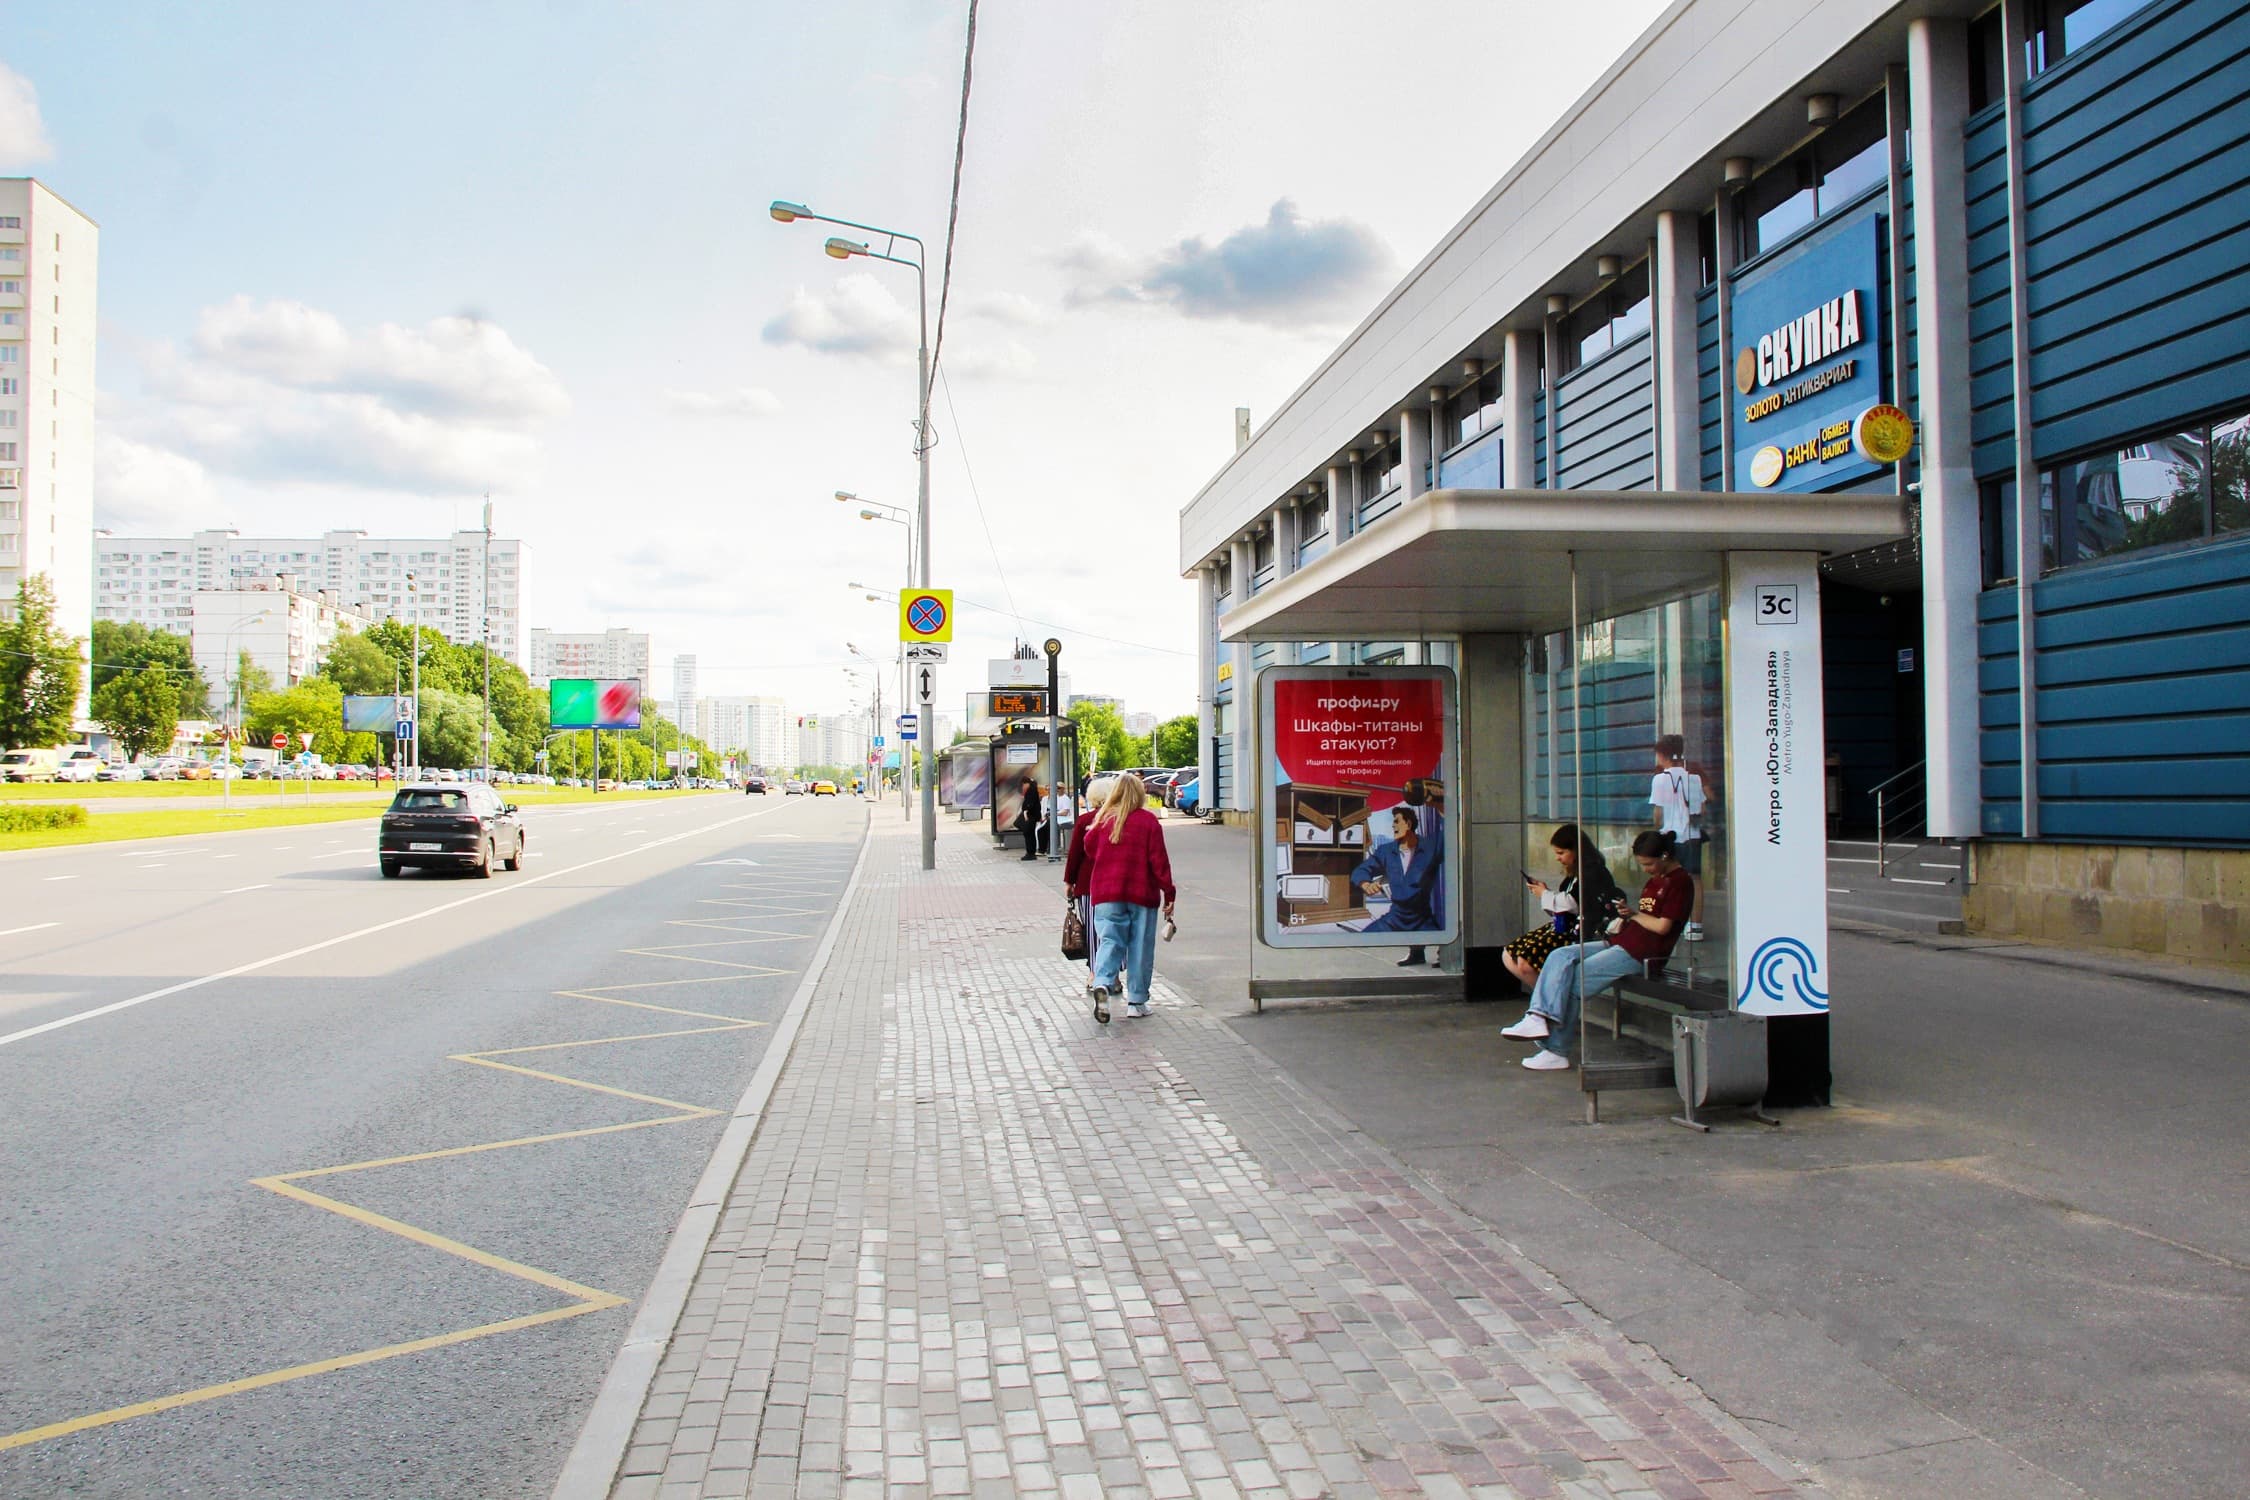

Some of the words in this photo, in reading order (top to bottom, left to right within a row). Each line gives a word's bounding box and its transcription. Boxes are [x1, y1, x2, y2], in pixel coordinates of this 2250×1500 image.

[1757, 289, 1862, 387] СКУПКА
[1745, 393, 1781, 422] ЗОЛОТО
[1783, 360, 1854, 406] АНТИКВАРИАТ
[1821, 420, 1850, 442] ОБМЕН
[1785, 438, 1818, 468] БАНК
[1821, 438, 1850, 461] ВАЛЮТ
[1294, 719, 1423, 735] Шкафы-титаны
[1766, 650, 1780, 785] «Юго-Западная»
[1320, 735, 1397, 752] атакуют?
[1306, 759, 1331, 767] Ищите
[1332, 758, 1412, 767] героев-мебельщиков
[1783, 740, 1792, 775] Metro
[1347, 767, 1382, 776] Профи.ру
[1768, 789, 1783, 845] Метро
[1290, 914, 1307, 925] 6+
